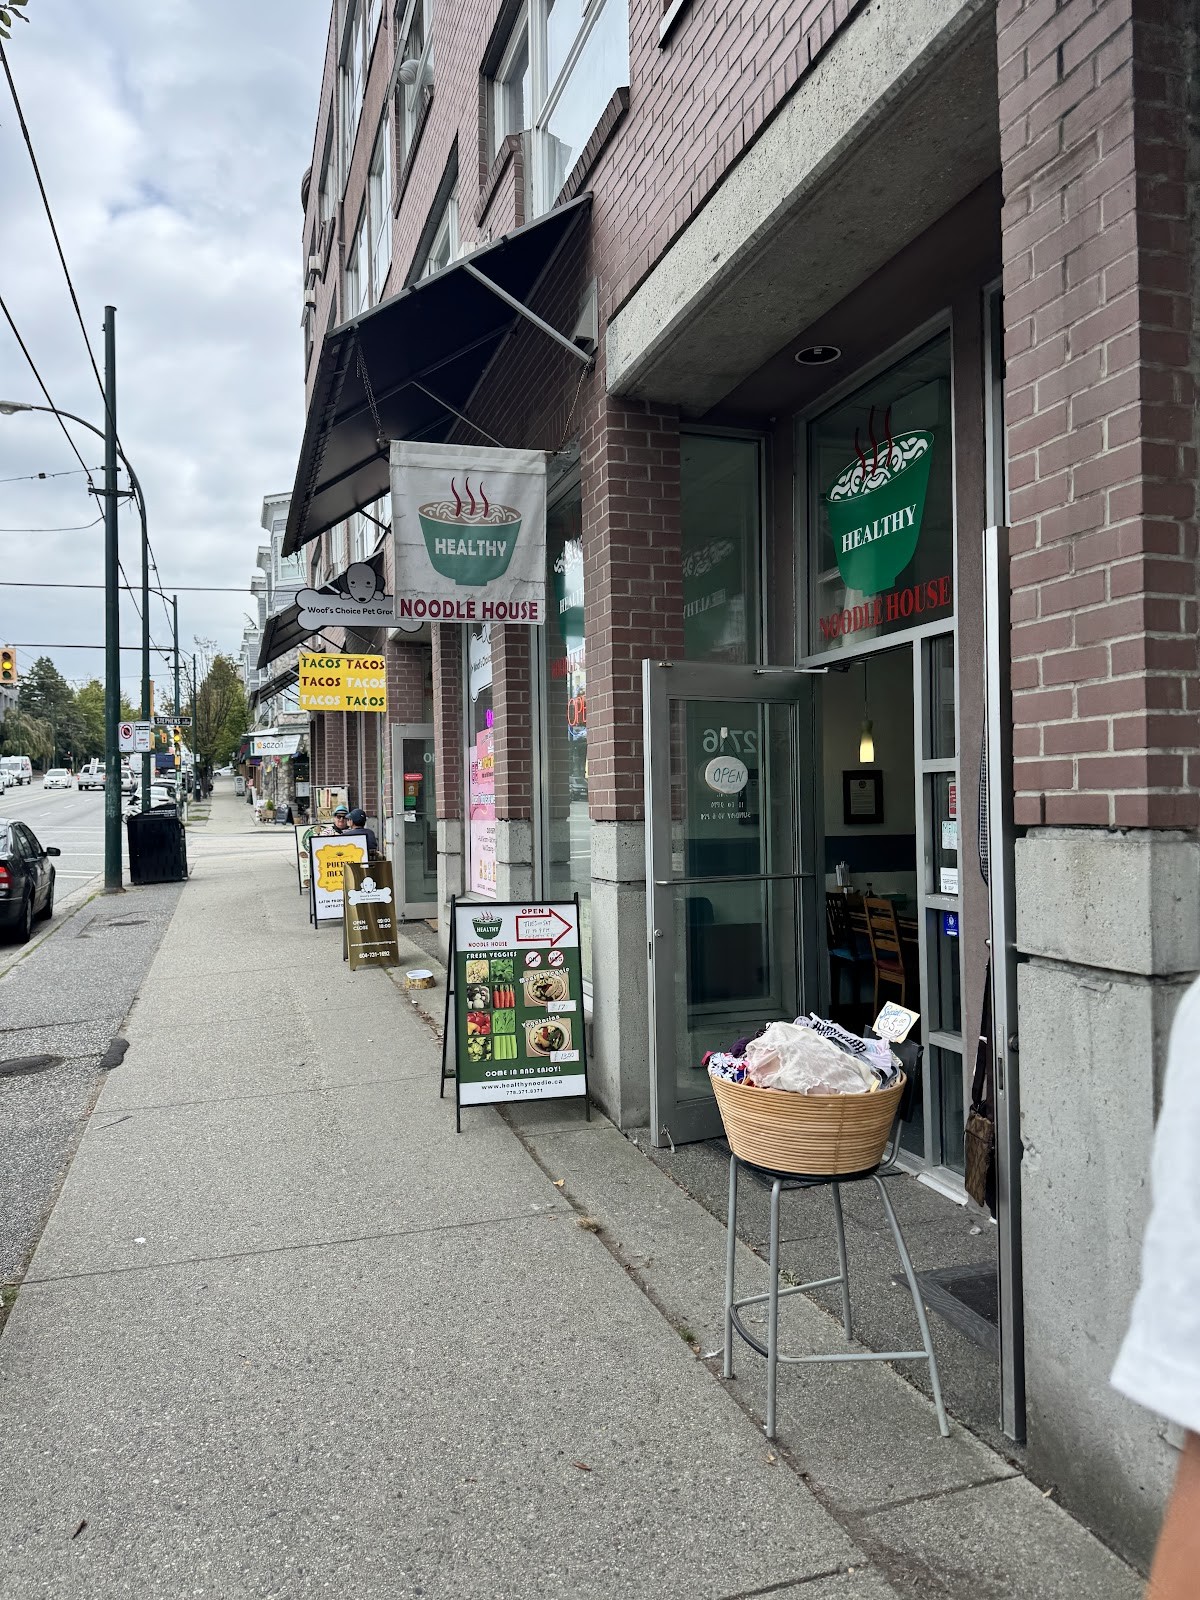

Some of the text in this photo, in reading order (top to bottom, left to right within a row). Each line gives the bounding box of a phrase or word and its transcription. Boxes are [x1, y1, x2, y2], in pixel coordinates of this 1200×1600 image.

[841, 503, 917, 554] HEALTHY
[434, 537, 507, 557] HEALTHY
[307, 606, 334, 614] Woof's
[400, 598, 538, 620] NOODLE HOUSE
[819, 575, 951, 640] NOODLE HOUSE
[302, 658, 385, 670] TACOS TACOS
[302, 676, 386, 688] TACOS TACOS
[301, 694, 385, 707] TACOS TACOS
[713, 767, 744, 784] OPEN
[521, 1014, 560, 1028] Vegetarian
[485, 1070, 508, 1078] COME
